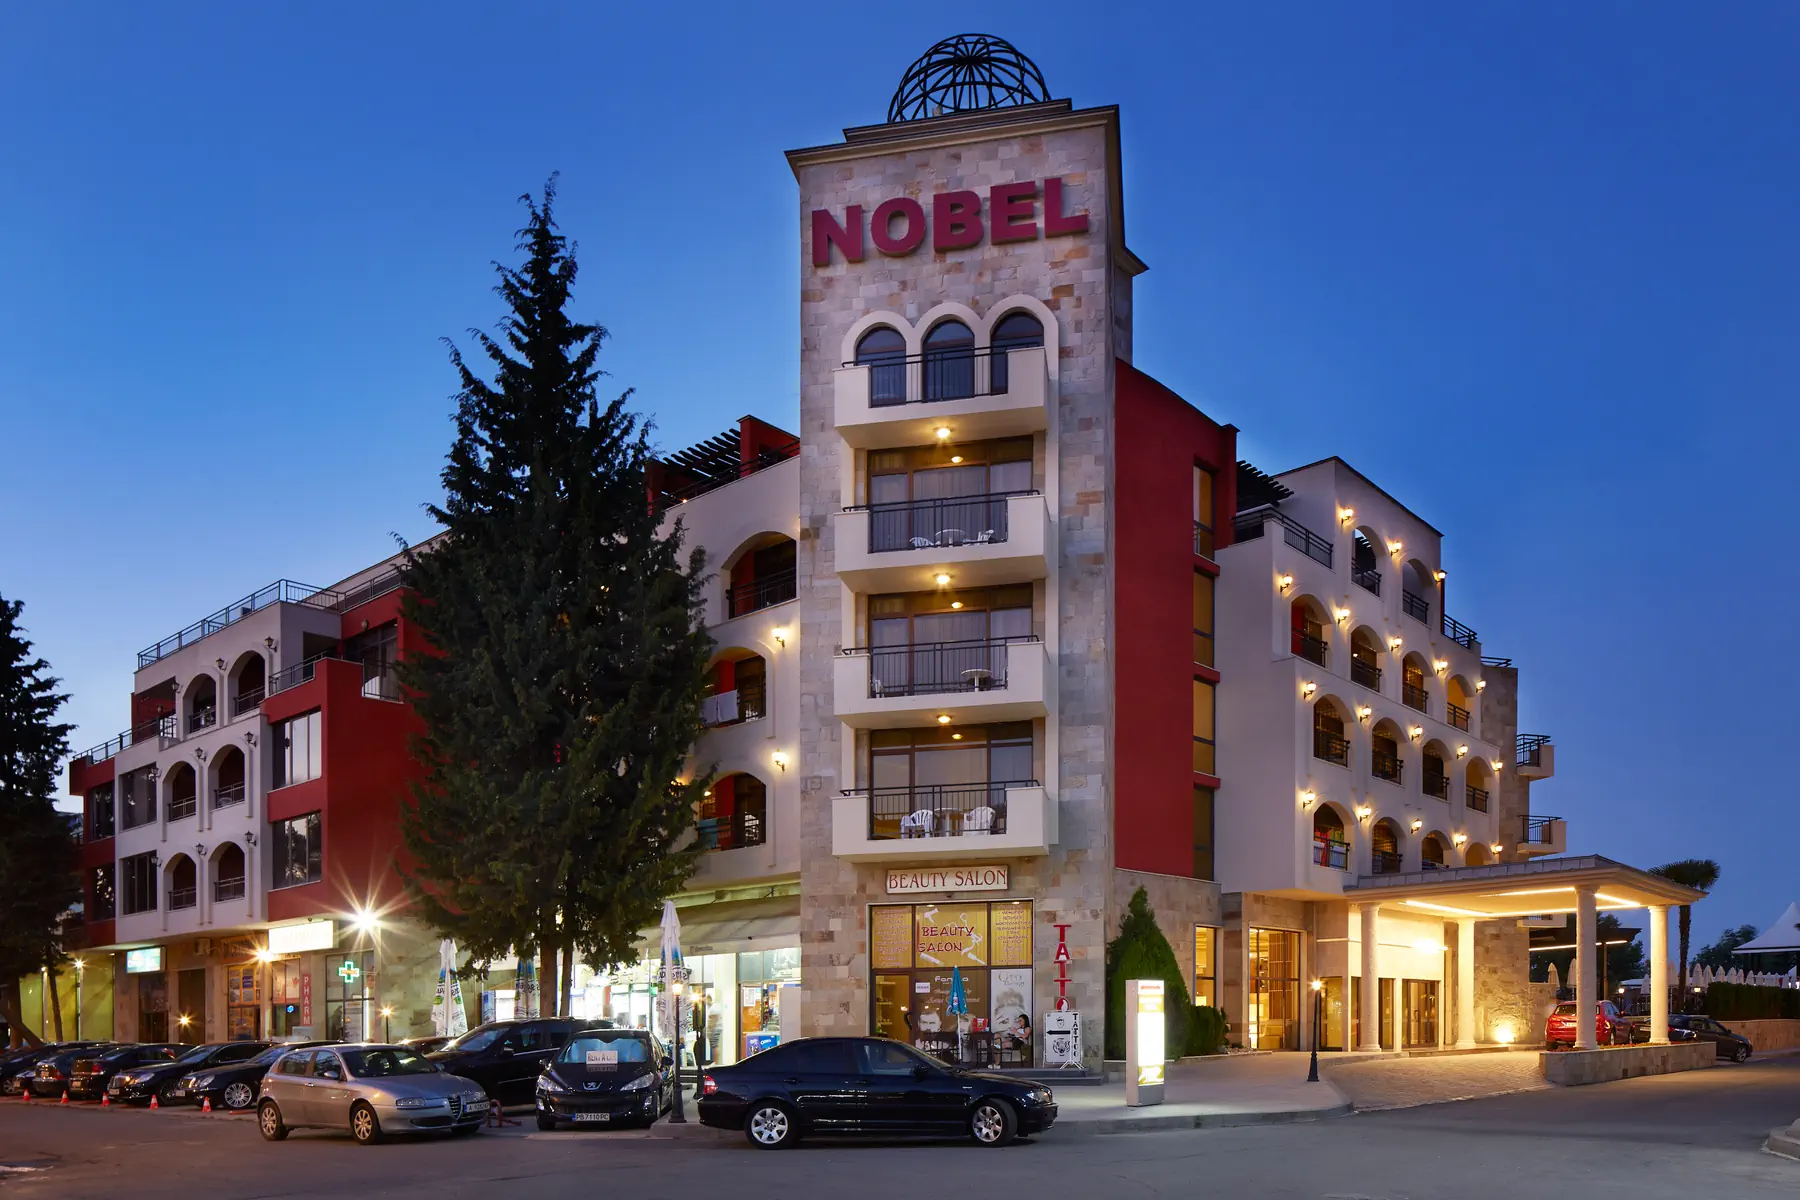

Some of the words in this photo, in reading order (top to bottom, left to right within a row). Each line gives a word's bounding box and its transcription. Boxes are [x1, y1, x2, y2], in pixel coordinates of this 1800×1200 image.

[811, 177, 1089, 267] NOBEL
[889, 872, 949, 889] BEAUTY
[955, 869, 1007, 887] SALON
[921, 926, 975, 937] BEAUTY
[918, 942, 963, 953] SALON
[303, 976, 311, 1025] PHARM
